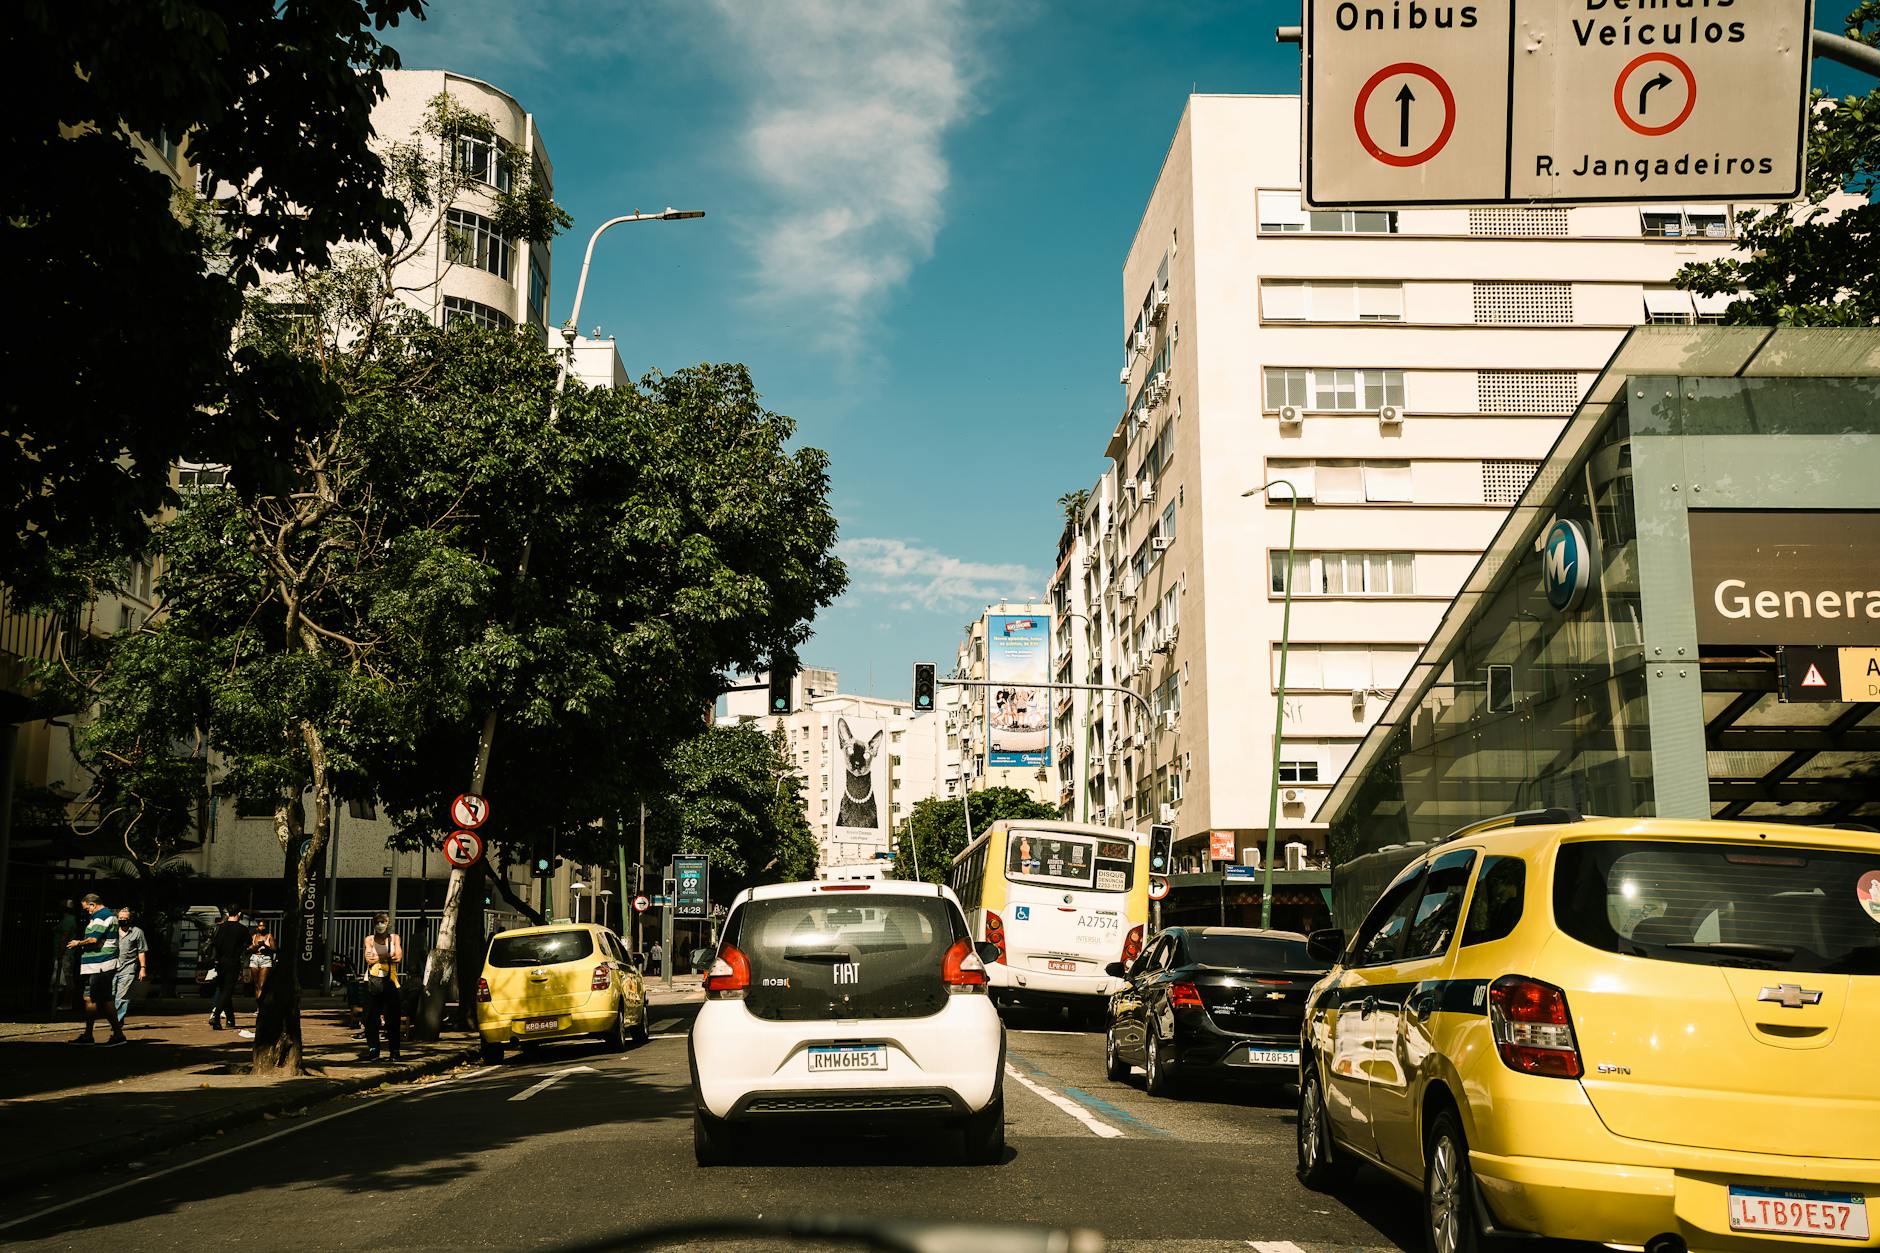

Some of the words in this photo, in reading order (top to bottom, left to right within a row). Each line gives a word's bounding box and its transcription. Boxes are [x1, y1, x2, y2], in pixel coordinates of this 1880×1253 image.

[1572, 16, 1745, 46] Veículos
[1536, 155, 1560, 176] R.
[1572, 153, 1773, 182] Jangadeiros
[1098, 870, 1124, 879] DISQUE
[682, 878, 698, 888] 69
[1077, 915, 1119, 929] A27574
[302, 914, 315, 962] General
[833, 963, 860, 985] FIAT
[815, 1052, 879, 1068] RMW6H51
[1253, 1052, 1295, 1063] LTZ8F51
[1597, 1064, 1631, 1075] SPIN
[1784, 1191, 1807, 1199] BRASIL
[1741, 1199, 1851, 1231] LTB9E57
